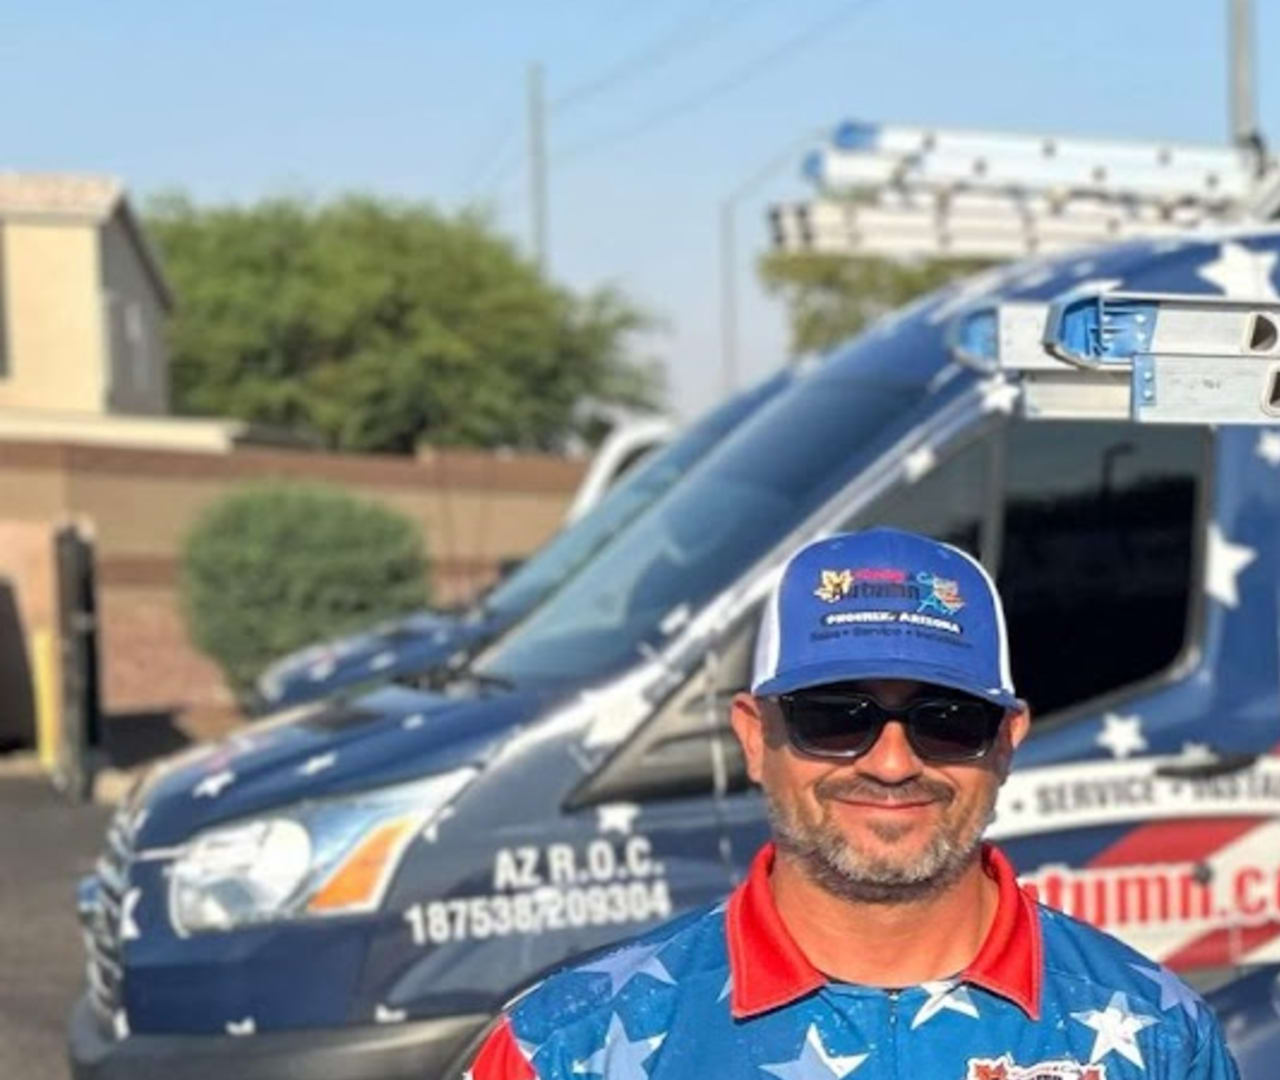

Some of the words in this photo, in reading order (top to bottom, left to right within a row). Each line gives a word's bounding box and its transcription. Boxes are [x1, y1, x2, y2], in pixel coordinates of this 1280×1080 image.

[1034, 777, 1153, 815] SERVICE
[494, 847, 542, 889] AZ
[547, 837, 665, 884] R.O.C.
[404, 879, 673, 945] 187538/209304
